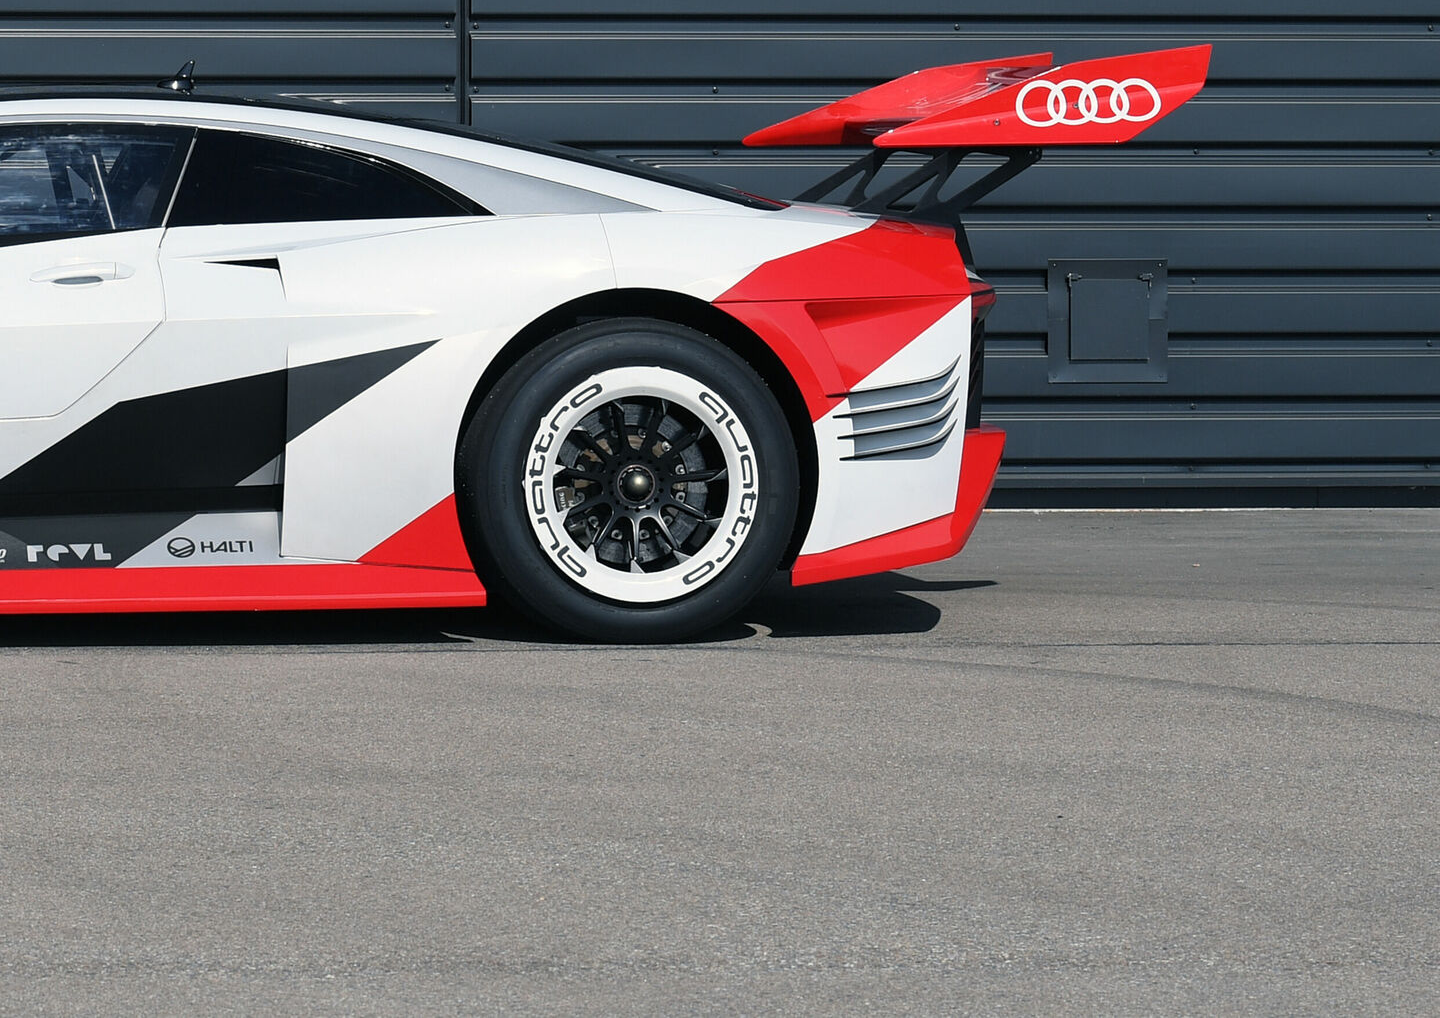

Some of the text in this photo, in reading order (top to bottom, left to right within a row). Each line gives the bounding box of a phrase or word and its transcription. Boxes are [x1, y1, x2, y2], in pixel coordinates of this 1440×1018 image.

[200, 540, 254, 553] HALTI
[528, 382, 603, 578] quattro
[682, 391, 757, 586] quattro
